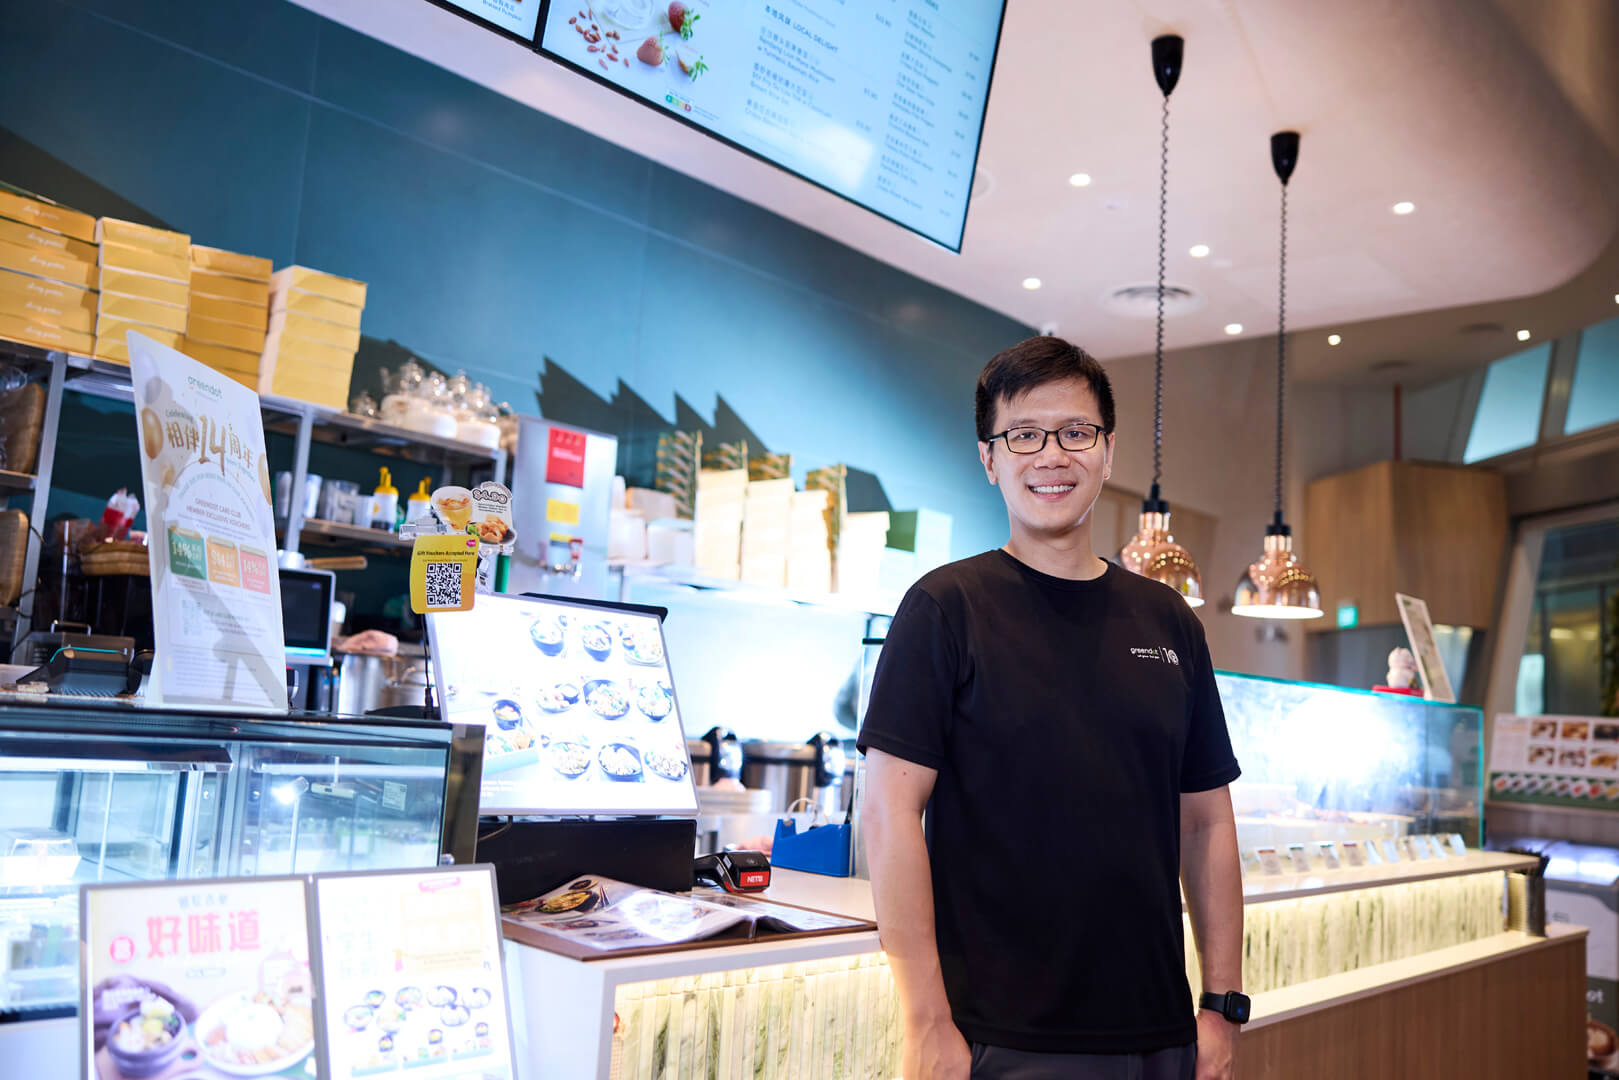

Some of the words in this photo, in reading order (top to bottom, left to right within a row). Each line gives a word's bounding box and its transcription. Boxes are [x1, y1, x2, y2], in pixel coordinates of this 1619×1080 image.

[792, 23, 812, 40] LOCAL
[813, 34, 839, 54] DELIGHT
[146, 909, 261, 959] 好味道
